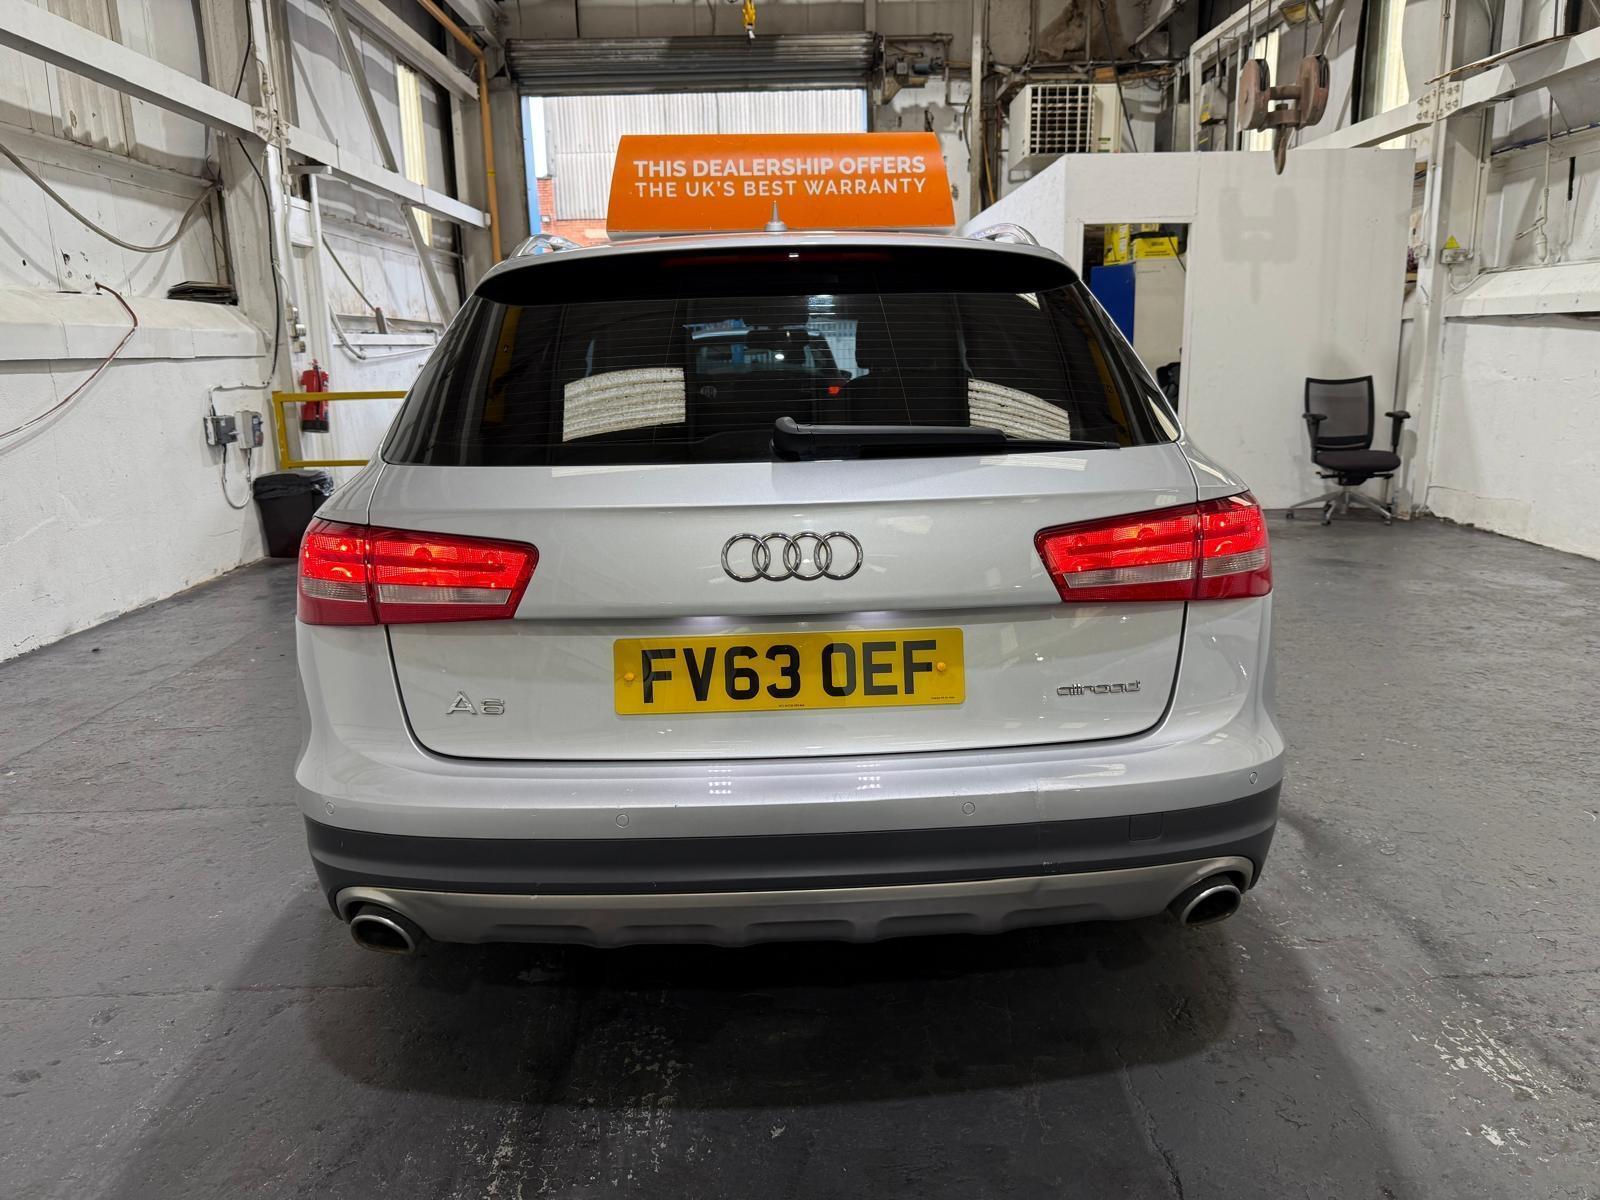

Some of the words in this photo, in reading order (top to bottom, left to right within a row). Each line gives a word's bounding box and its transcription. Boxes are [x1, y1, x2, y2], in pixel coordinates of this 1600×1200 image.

[633, 159, 687, 178] THIS
[692, 157, 834, 177] DEALERSHIP
[839, 155, 926, 174] OFFERS
[635, 182, 678, 198] THE
[686, 180, 736, 197] UK'S
[743, 180, 797, 197] BEST
[804, 178, 927, 195] WARRANTY
[641, 644, 802, 704] FV63
[1057, 680, 1141, 696] allroad
[445, 690, 505, 715] A6
